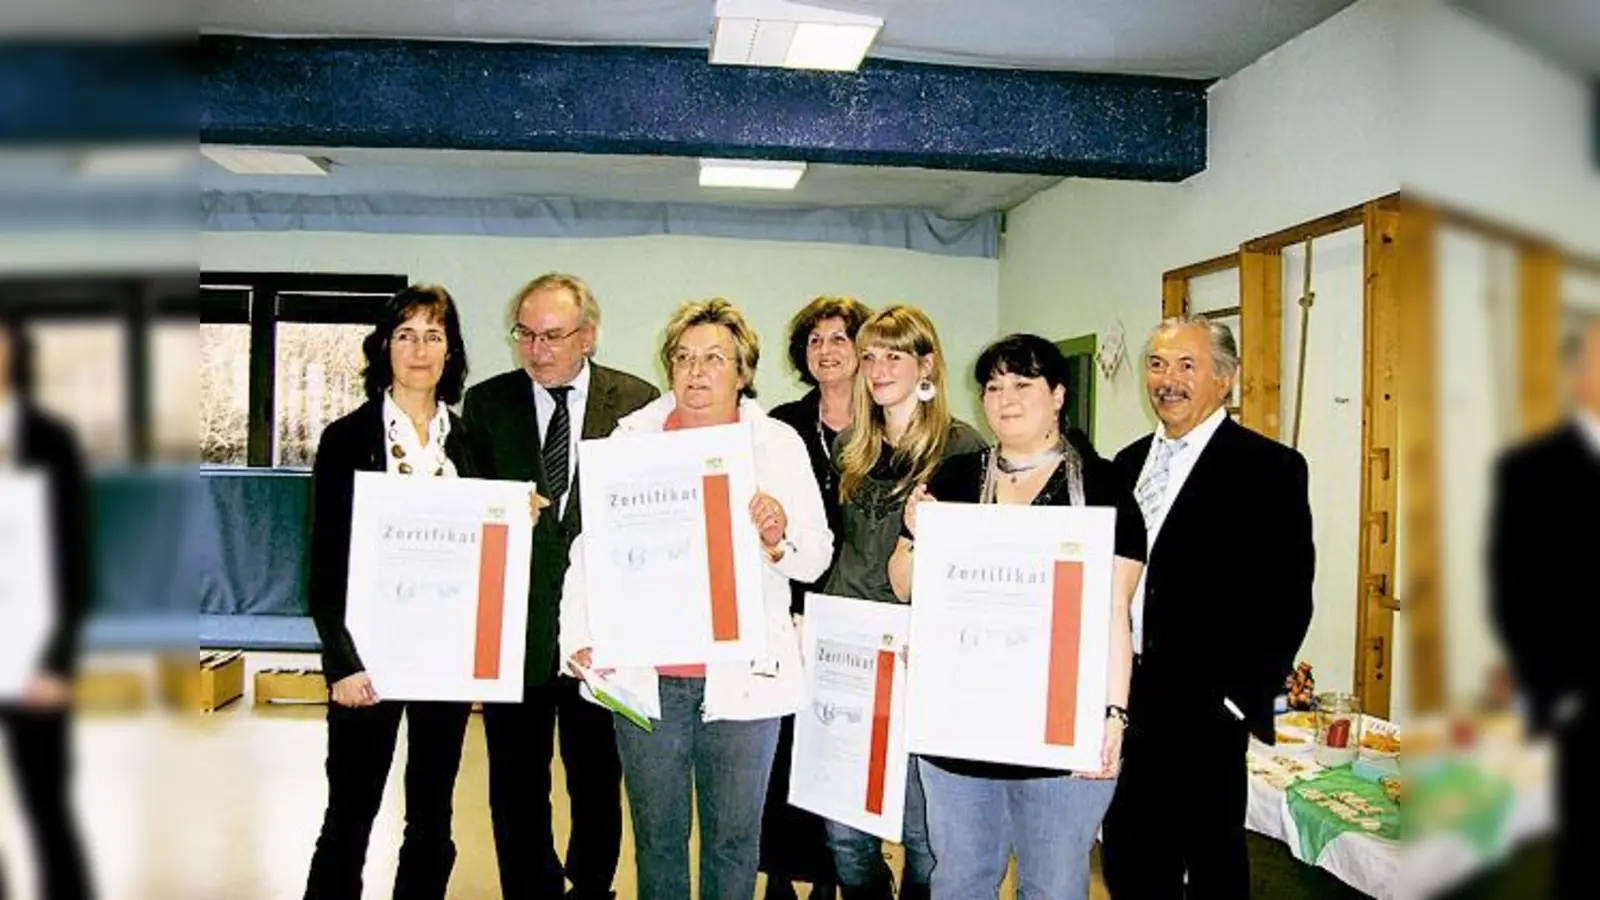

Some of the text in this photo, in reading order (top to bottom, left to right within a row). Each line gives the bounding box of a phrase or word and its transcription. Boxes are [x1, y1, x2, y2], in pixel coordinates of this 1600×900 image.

[609, 486, 697, 508] Zertifikat
[382, 524, 477, 545] Zertifikat
[945, 562, 1048, 585] Zertifikat
[817, 646, 875, 670] Zertifikat
